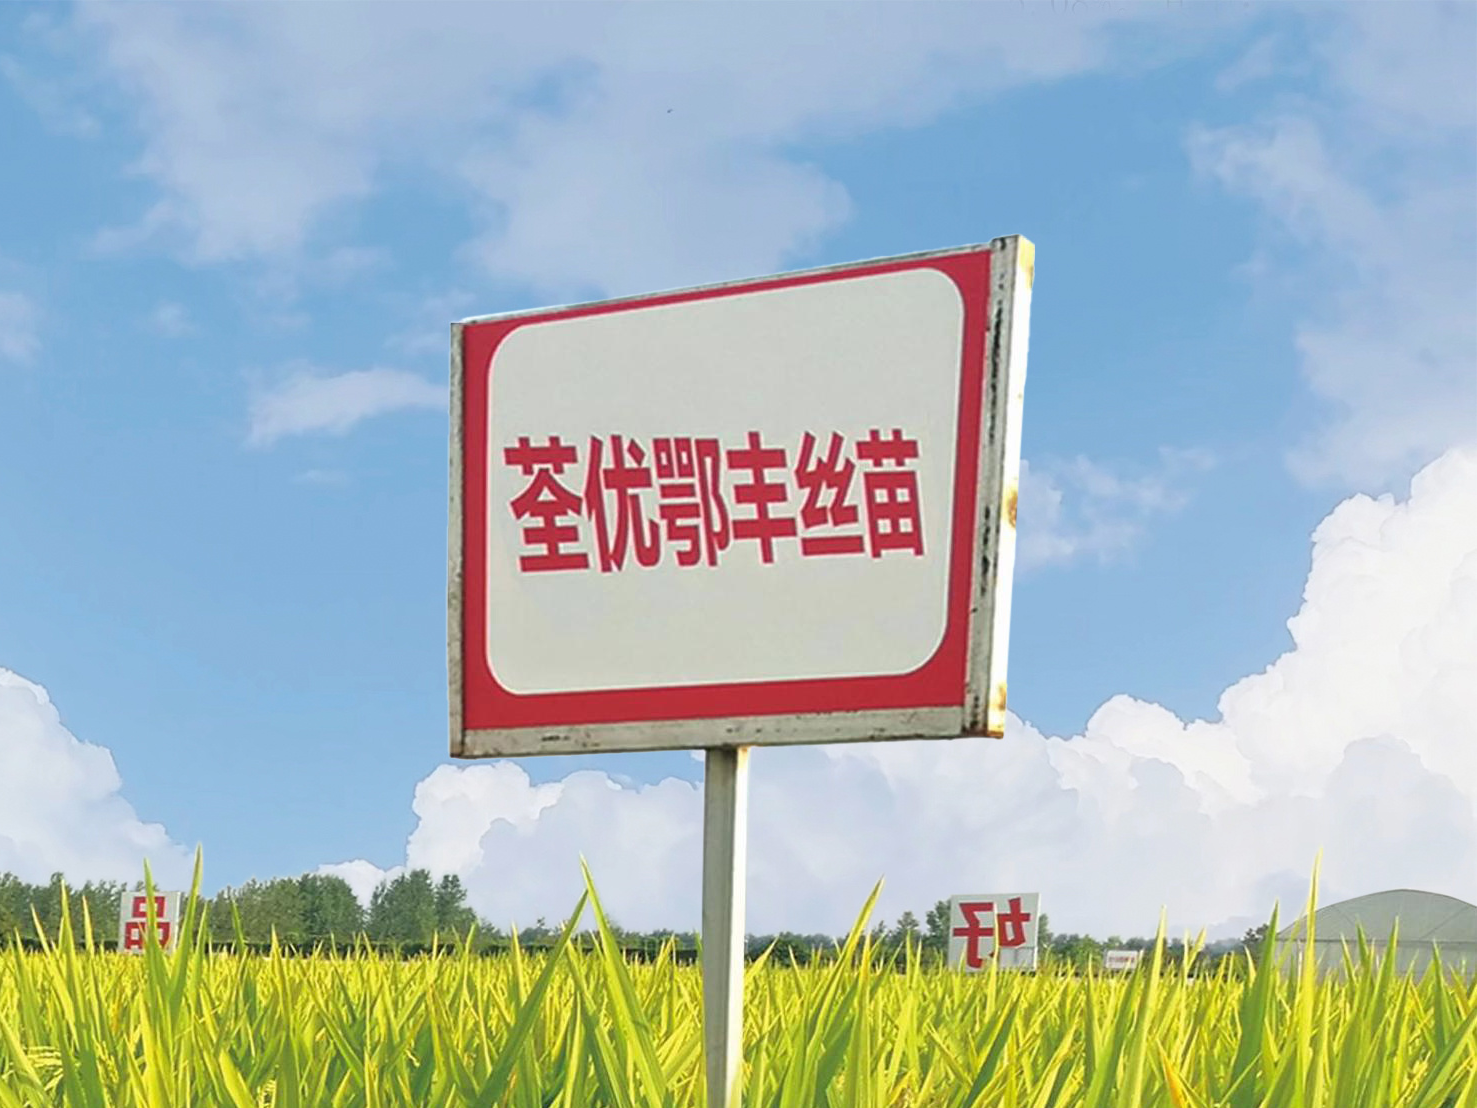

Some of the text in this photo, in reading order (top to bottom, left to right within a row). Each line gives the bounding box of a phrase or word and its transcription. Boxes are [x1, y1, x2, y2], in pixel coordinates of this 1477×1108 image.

[503, 428, 925, 574] 荃优鄂丰丝苗
